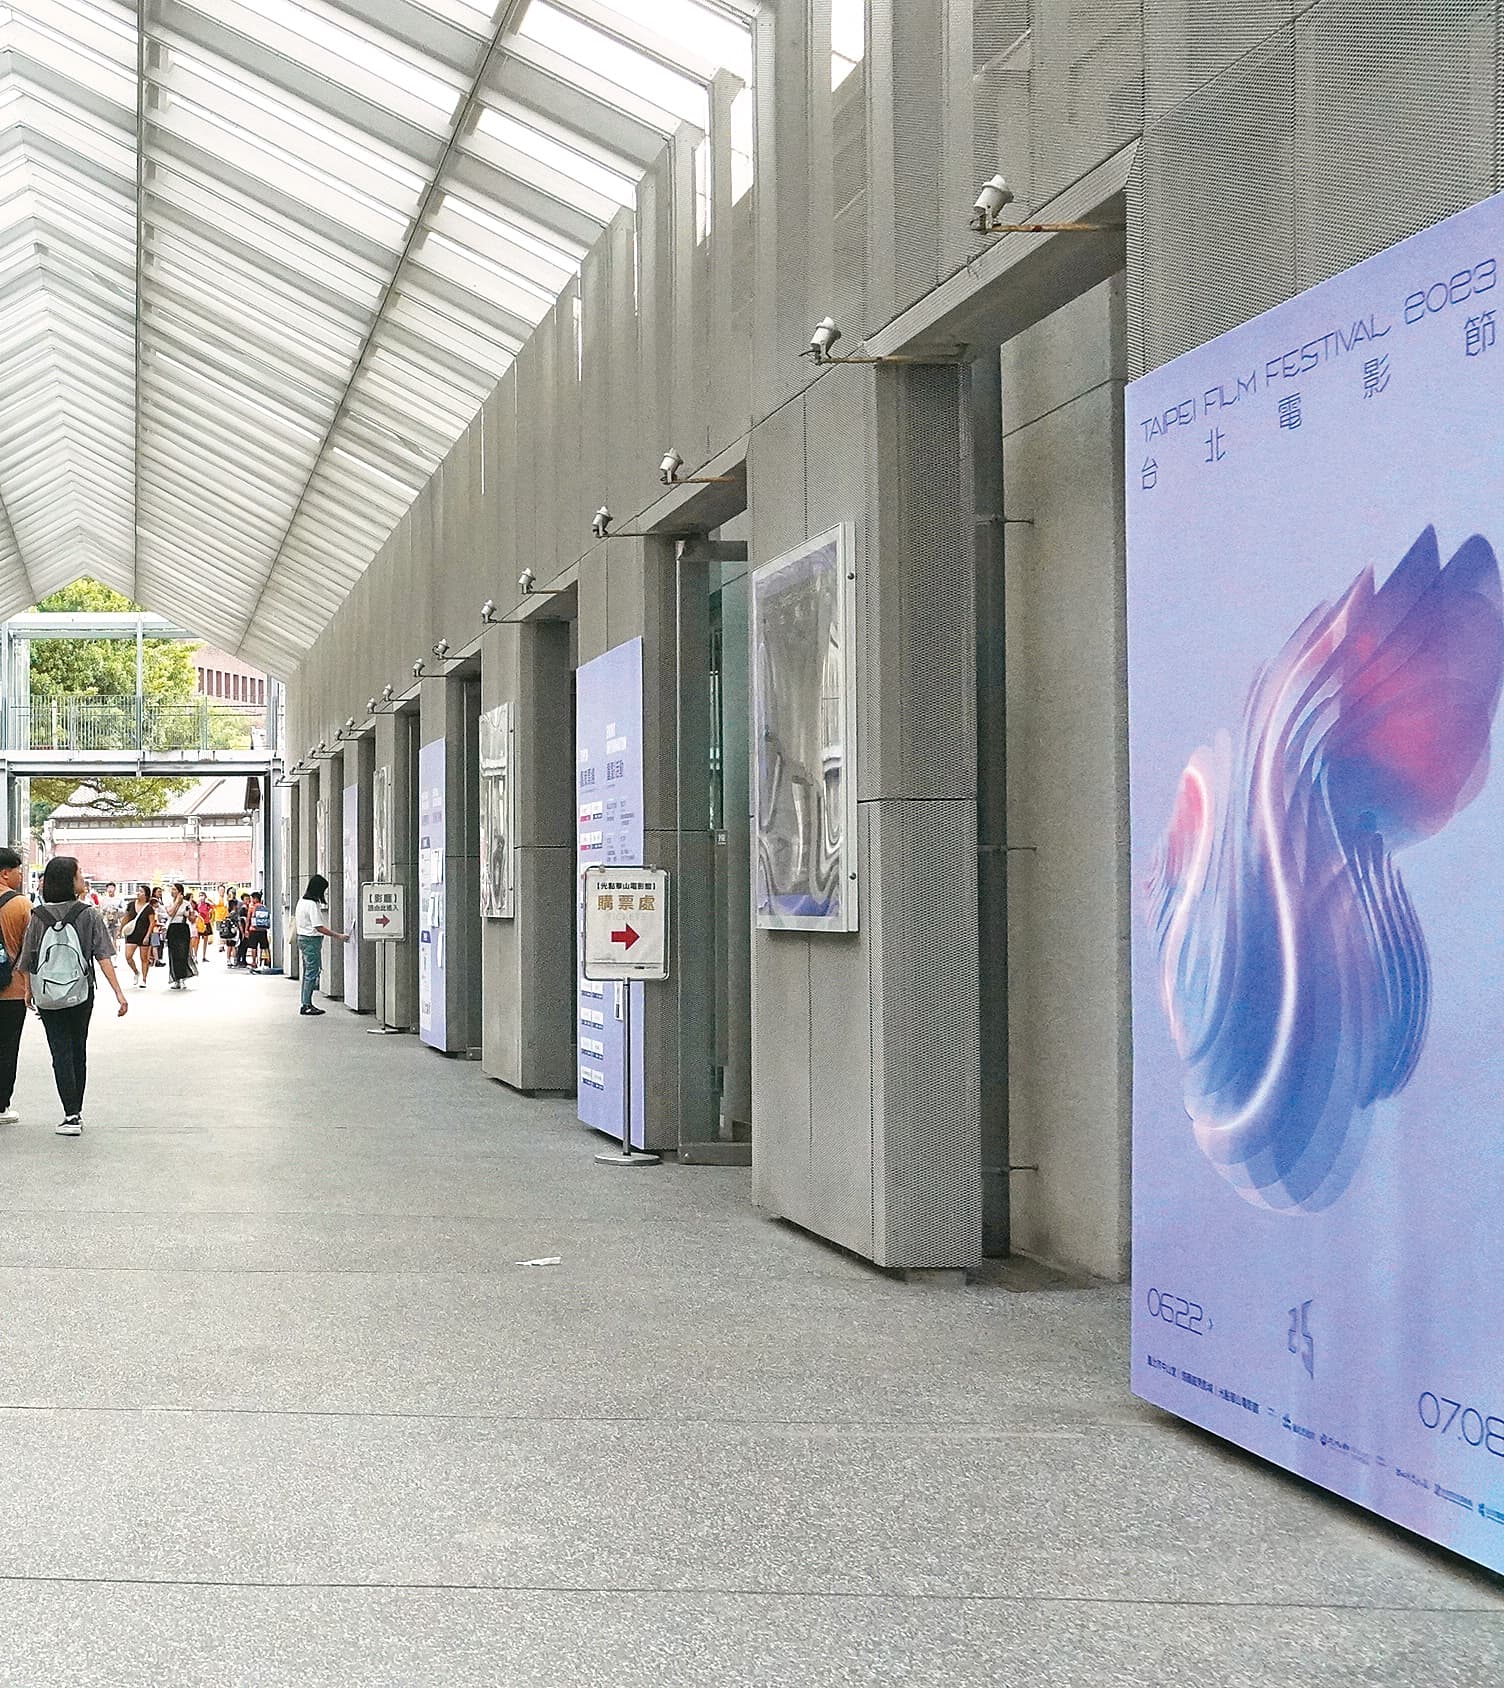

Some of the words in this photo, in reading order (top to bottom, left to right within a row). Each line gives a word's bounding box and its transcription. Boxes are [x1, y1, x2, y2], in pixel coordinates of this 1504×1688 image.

[1140, 398, 1197, 443] TAIPEI
[1203, 369, 1257, 417] FILM
[1265, 313, 1392, 388] FESTIVAL
[1403, 257, 1497, 326] 2023
[597, 894, 656, 911] 購票處
